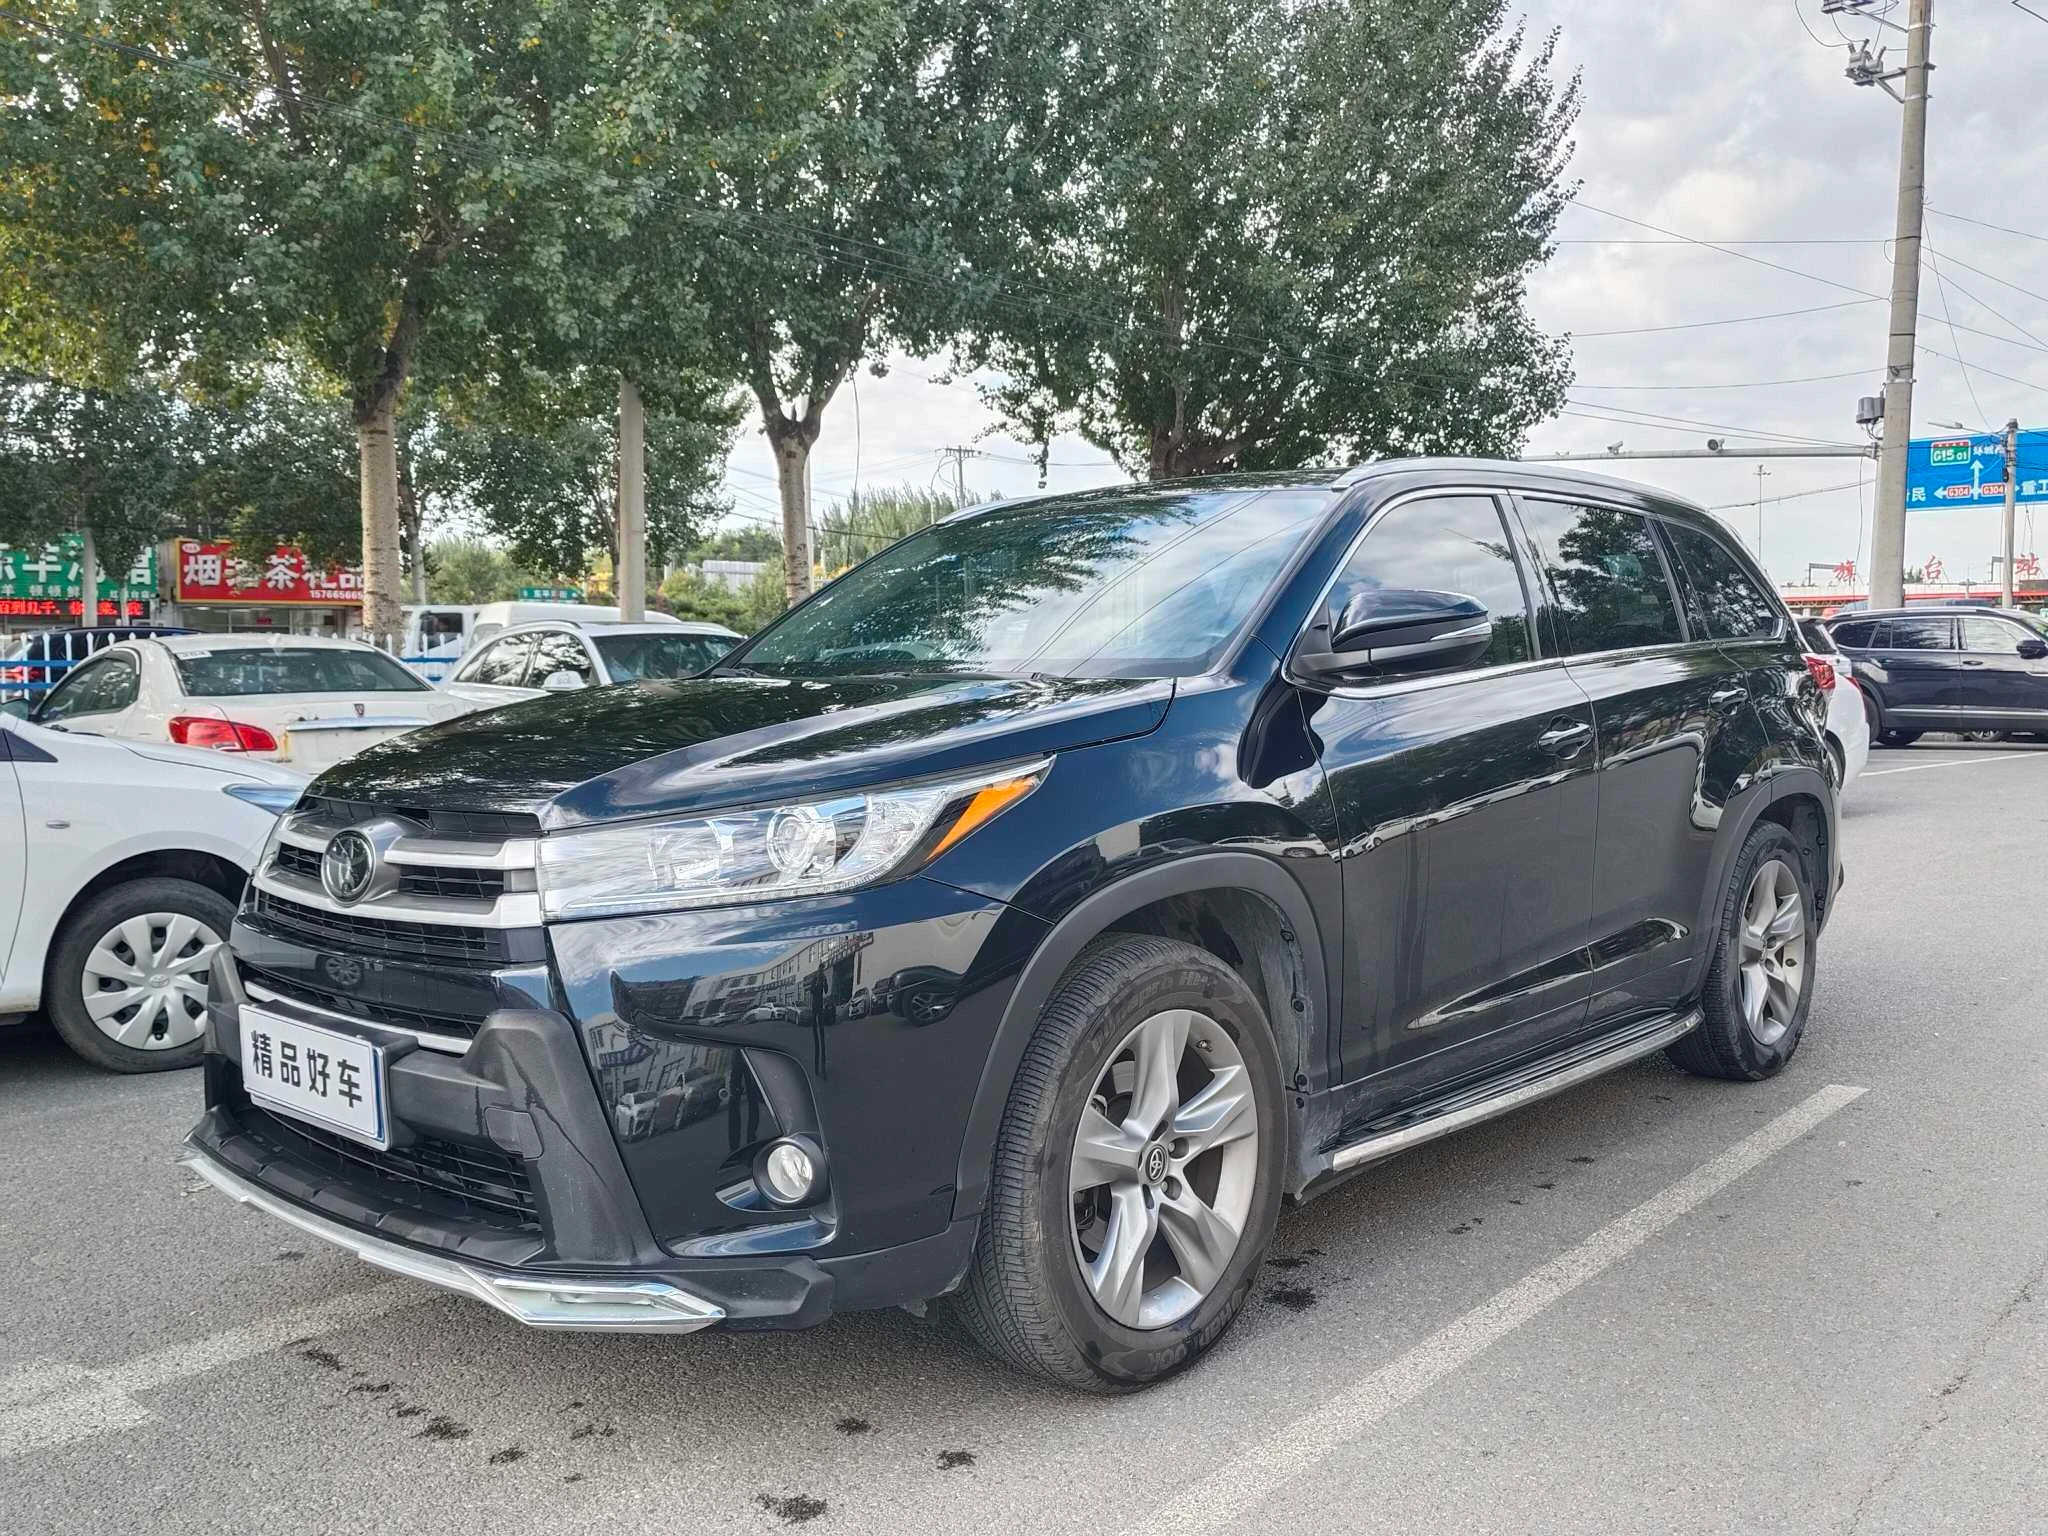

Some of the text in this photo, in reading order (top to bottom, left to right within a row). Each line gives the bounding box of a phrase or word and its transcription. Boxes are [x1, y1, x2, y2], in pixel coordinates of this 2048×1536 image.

[1983, 485, 2003, 495] G304
[252, 1030, 362, 1108] 精品好车
